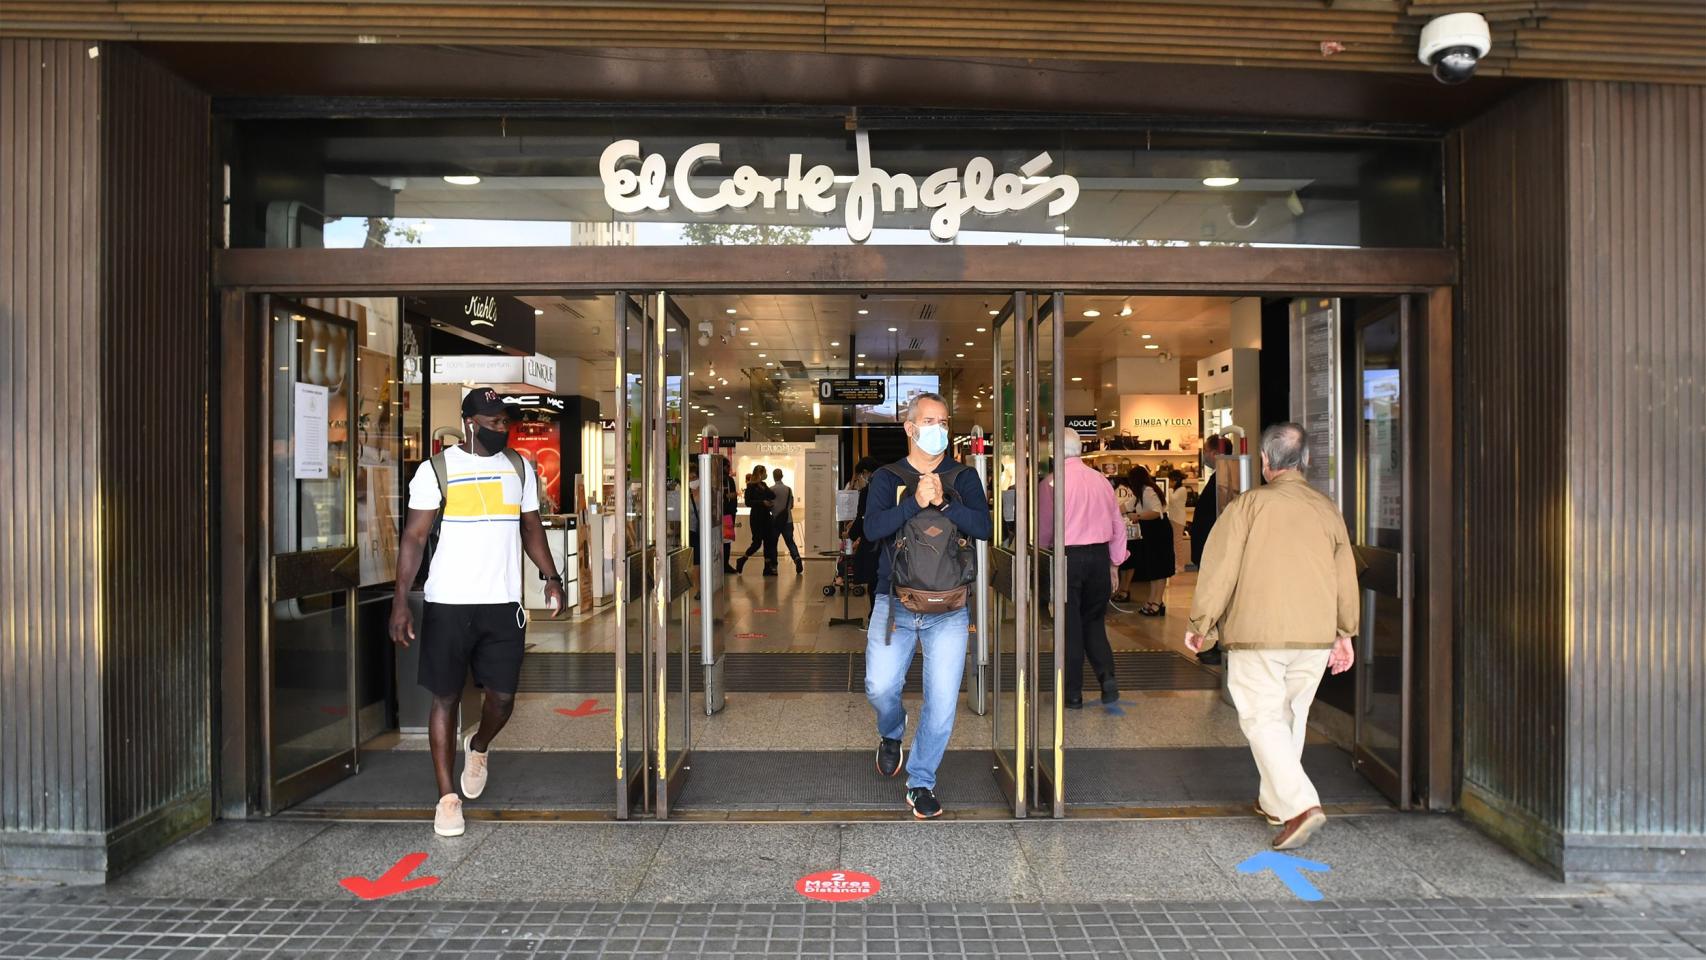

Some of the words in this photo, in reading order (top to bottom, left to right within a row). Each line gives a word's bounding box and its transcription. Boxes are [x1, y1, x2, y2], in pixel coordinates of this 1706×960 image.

[599, 139, 671, 214] El
[673, 142, 837, 214] Corte
[844, 129, 1081, 243] Inglés
[464, 295, 498, 322] Kiehl's
[528, 358, 553, 384] CLINIQUE
[1134, 418, 1162, 426] BIMBA
[1163, 418, 1169, 426] Y
[1171, 418, 1192, 426] LOLA
[805, 880, 871, 889] Metres
[830, 873, 846, 881] 2
